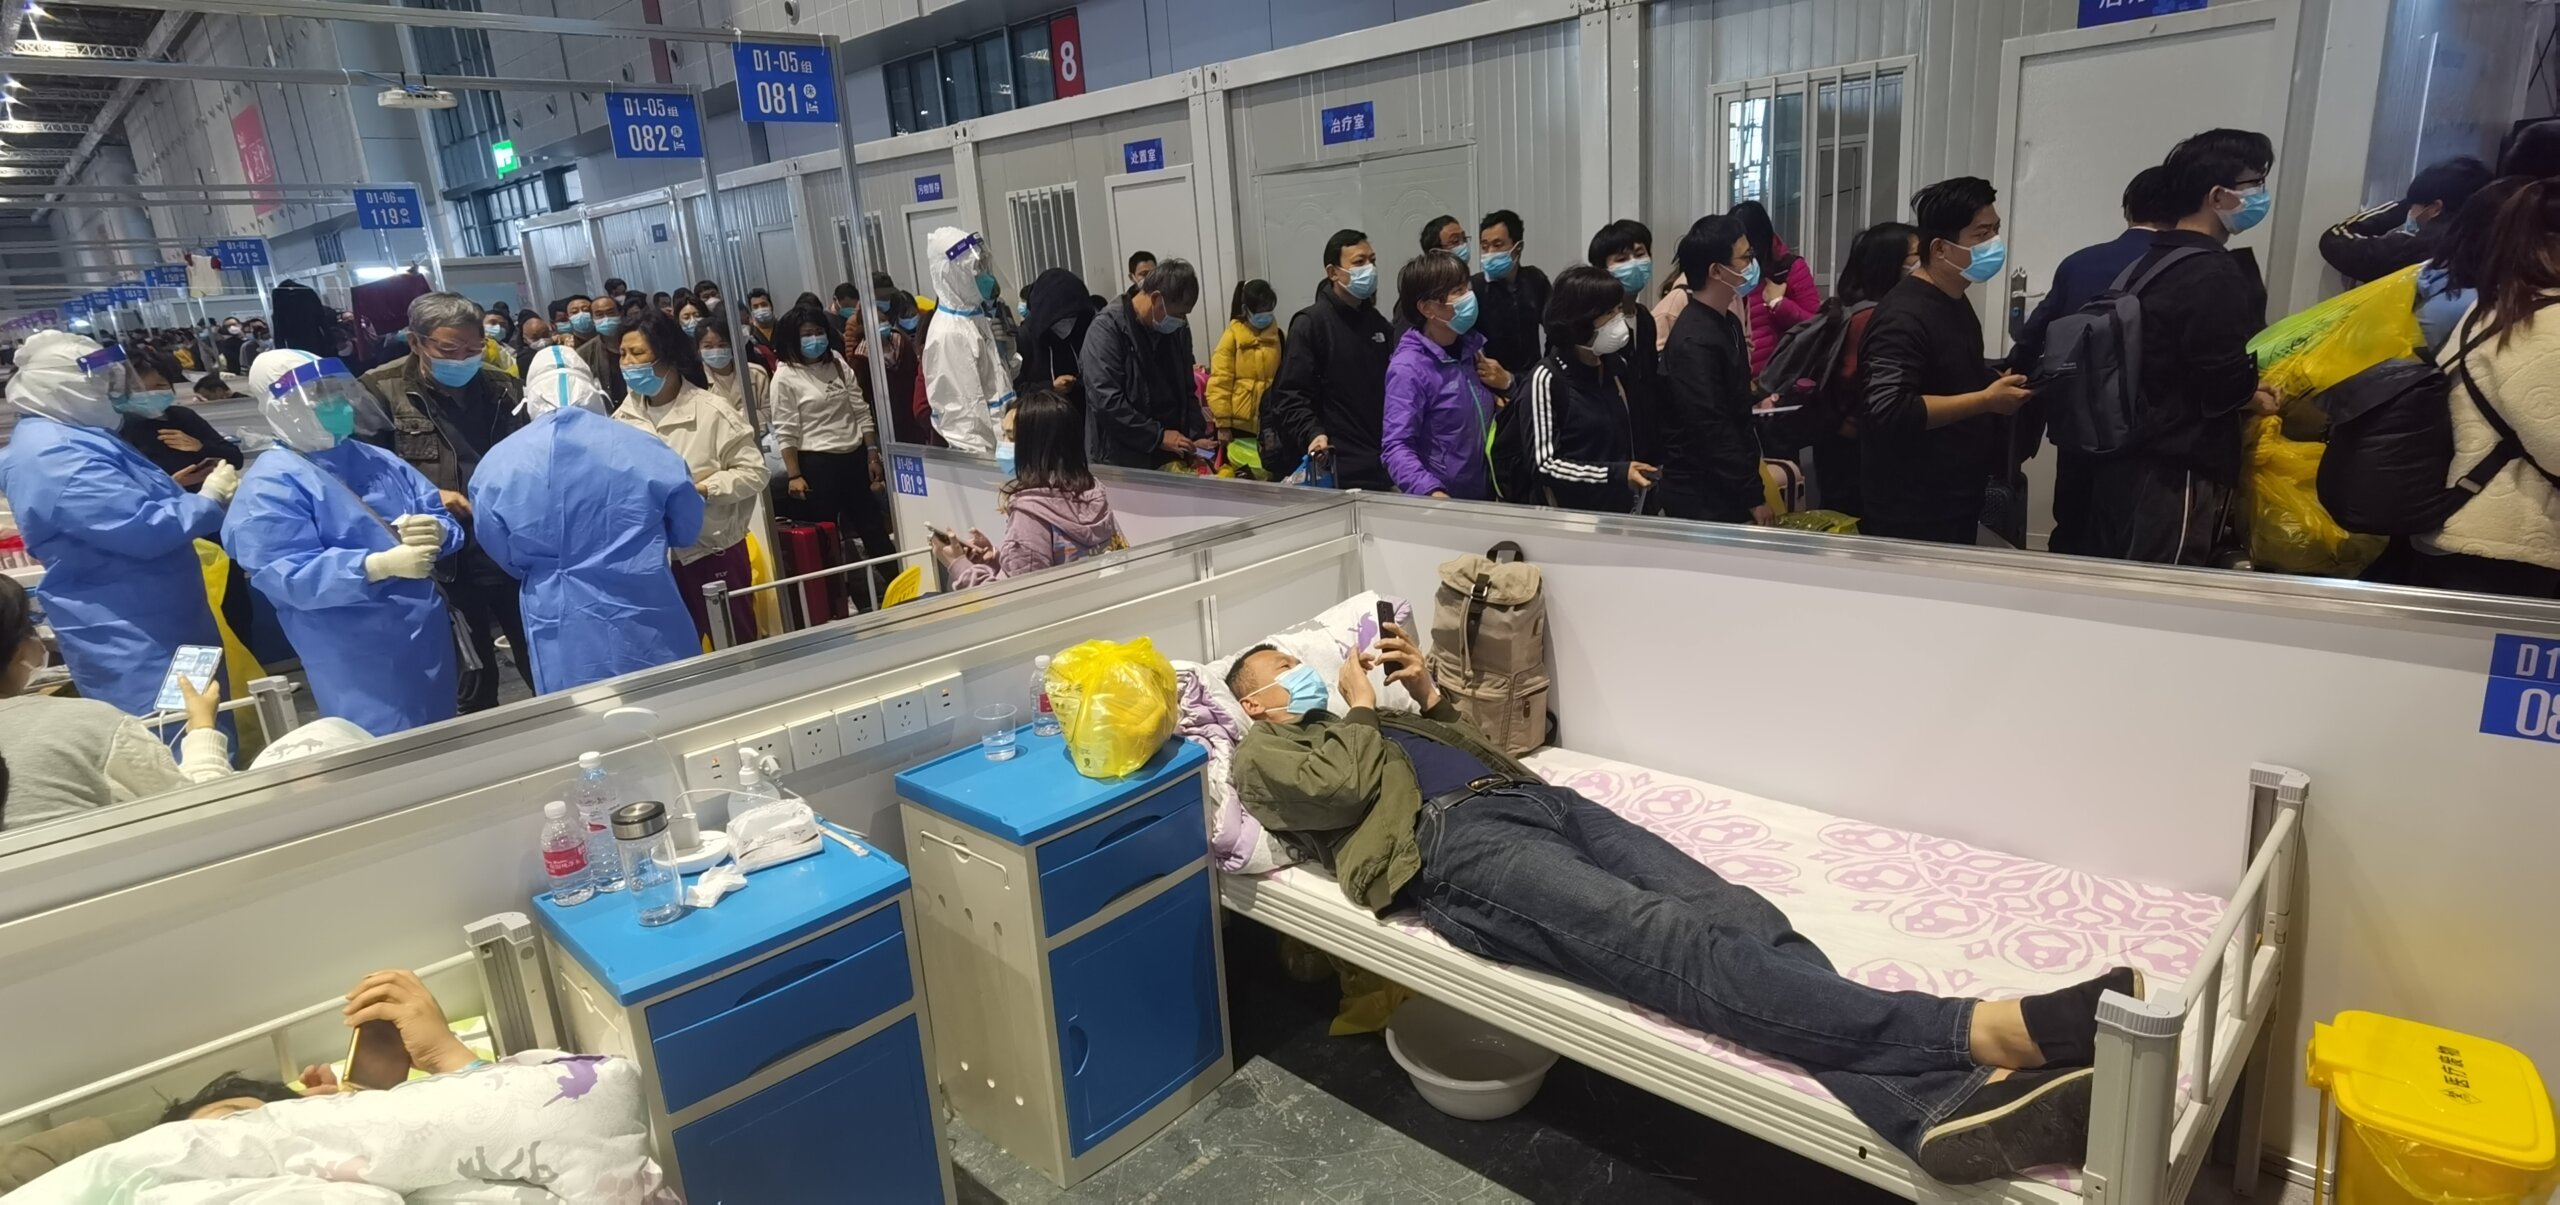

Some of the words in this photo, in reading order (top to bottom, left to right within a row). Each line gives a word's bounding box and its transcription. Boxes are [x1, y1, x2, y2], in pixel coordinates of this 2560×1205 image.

[752, 49, 799, 72] D1-05
[1060, 40, 1077, 82] 8
[623, 97, 666, 117] D1-05
[757, 81, 799, 115] 081
[1330, 113, 1366, 134] 治疗室
[628, 124, 670, 152] 082
[1130, 147, 1157, 165] 处置室
[370, 207, 399, 226] 119
[230, 252, 251, 265] 121
[900, 473, 916, 494] 081
